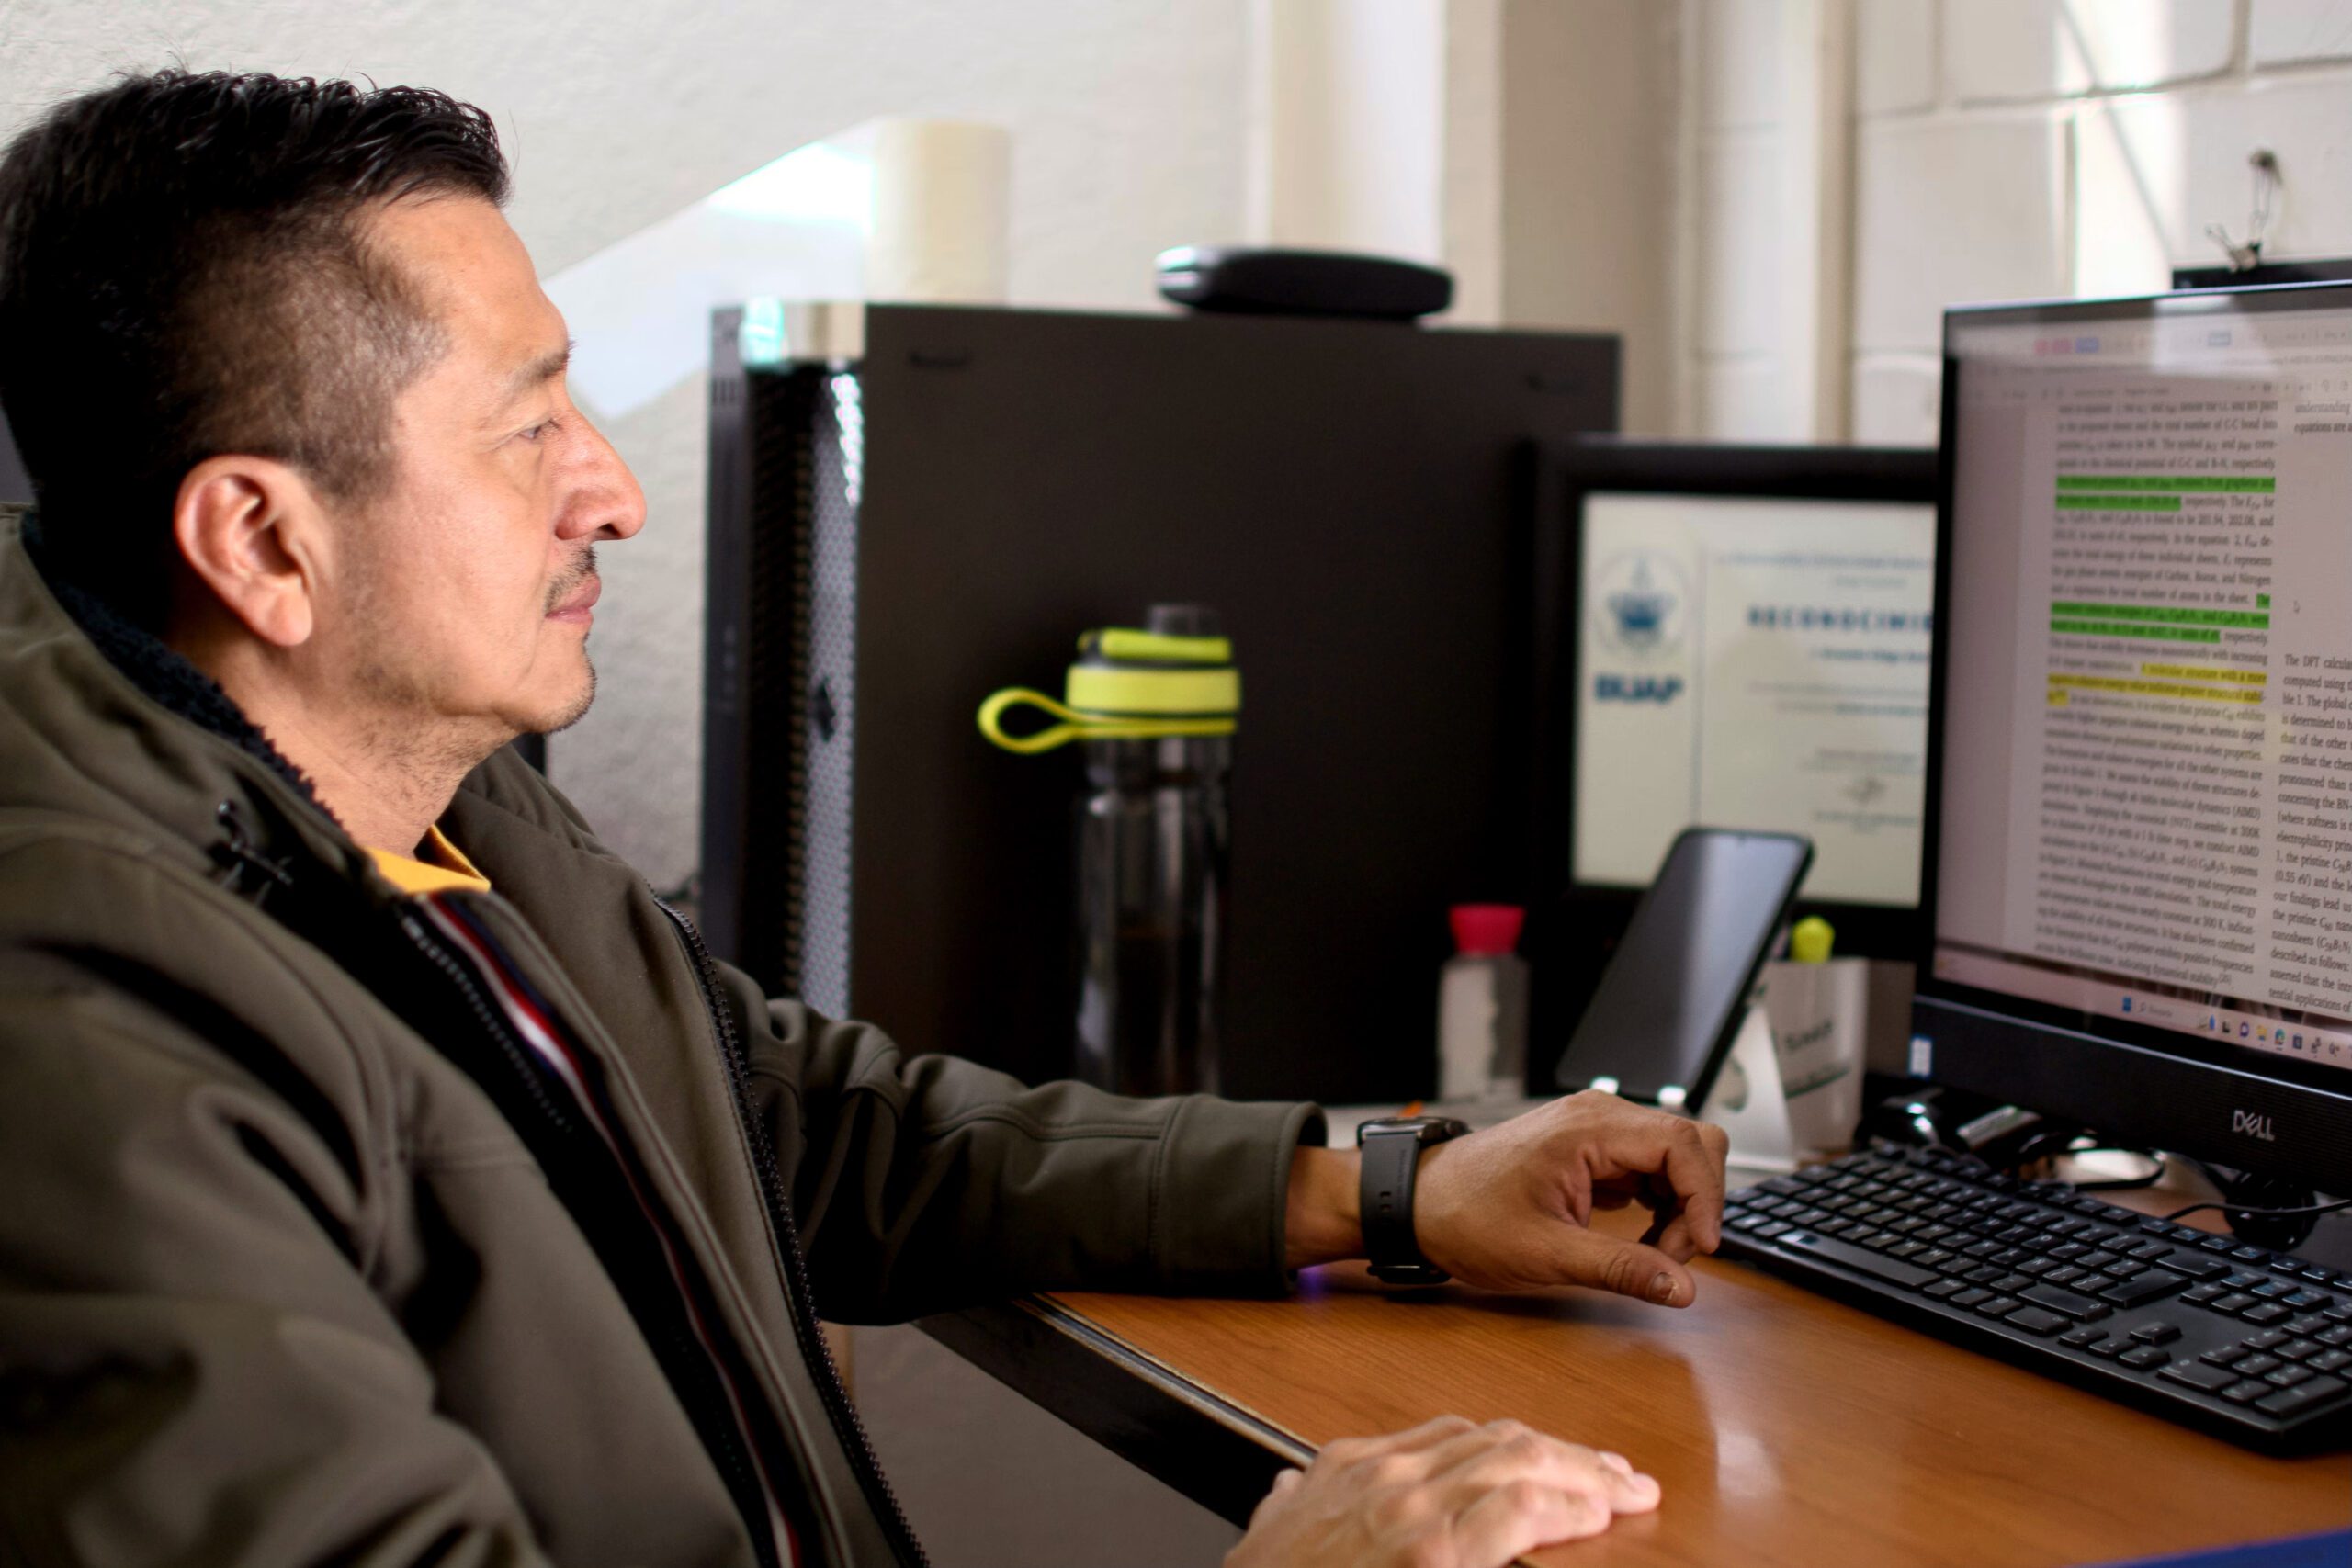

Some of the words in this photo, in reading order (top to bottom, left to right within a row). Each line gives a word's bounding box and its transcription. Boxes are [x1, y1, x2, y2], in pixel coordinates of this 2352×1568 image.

[2295, 402, 2351, 414] understanding
[2294, 422, 2332, 435] equations
[2333, 423, 2346, 434] are
[2231, 458, 2276, 471] respectively
[2259, 515, 2275, 526] and
[2234, 554, 2272, 568] represents
[2222, 572, 2236, 584] and
[2284, 654, 2299, 667] The
[2302, 655, 2320, 669] DFT
[2283, 674, 2322, 690] computed
[2324, 678, 2346, 693] using
[2307, 694, 2322, 708] The
[2323, 695, 2347, 711] global
[2290, 713, 2335, 729] determined
[2336, 718, 2346, 730] to
[2241, 728, 2265, 743] doped
[2280, 732, 2296, 745] that
[2300, 734, 2308, 746] of
[2311, 736, 2324, 749] the
[2325, 738, 2347, 751] other
[2280, 752, 2300, 766] cases
[2301, 753, 2317, 768] that
[2319, 755, 2332, 770] the
[2278, 773, 2324, 790] pronounced
[2328, 777, 2346, 792] than
[2278, 792, 2321, 810] concerning
[2323, 795, 2335, 809] the
[2278, 809, 2305, 827] (where
[2307, 813, 2338, 832] softness
[2340, 818, 2347, 831] is
[2276, 829, 2334, 852] electrophilicity
[2237, 843, 2260, 858] AIMD
[2286, 851, 2299, 864] the
[2301, 852, 2331, 871] pristine
[2230, 863, 2258, 878] systems
[2211, 880, 2257, 897] temperature
[2313, 875, 2329, 890] and
[2332, 878, 2345, 892] the
[2273, 890, 2287, 903] our
[2290, 891, 2321, 910] findings
[2323, 895, 2340, 911] lead
[2231, 902, 2256, 919] energy
[2272, 908, 2286, 921] the
[2288, 910, 2317, 928] pristine
[2217, 937, 2255, 955] confirmed
[2271, 928, 2314, 947] nanosheets
[2211, 954, 2254, 975] frequencies
[2270, 946, 2308, 965] described
[2309, 954, 2318, 967] as
[2269, 967, 2301, 984] asserted
[2303, 971, 2320, 987] that
[2322, 976, 2335, 991] the
[2268, 987, 2294, 1002] tential
[2294, 991, 2342, 1013] applications
[2343, 997, 2352, 1011] of
[2232, 1110, 2275, 1142] DELL
